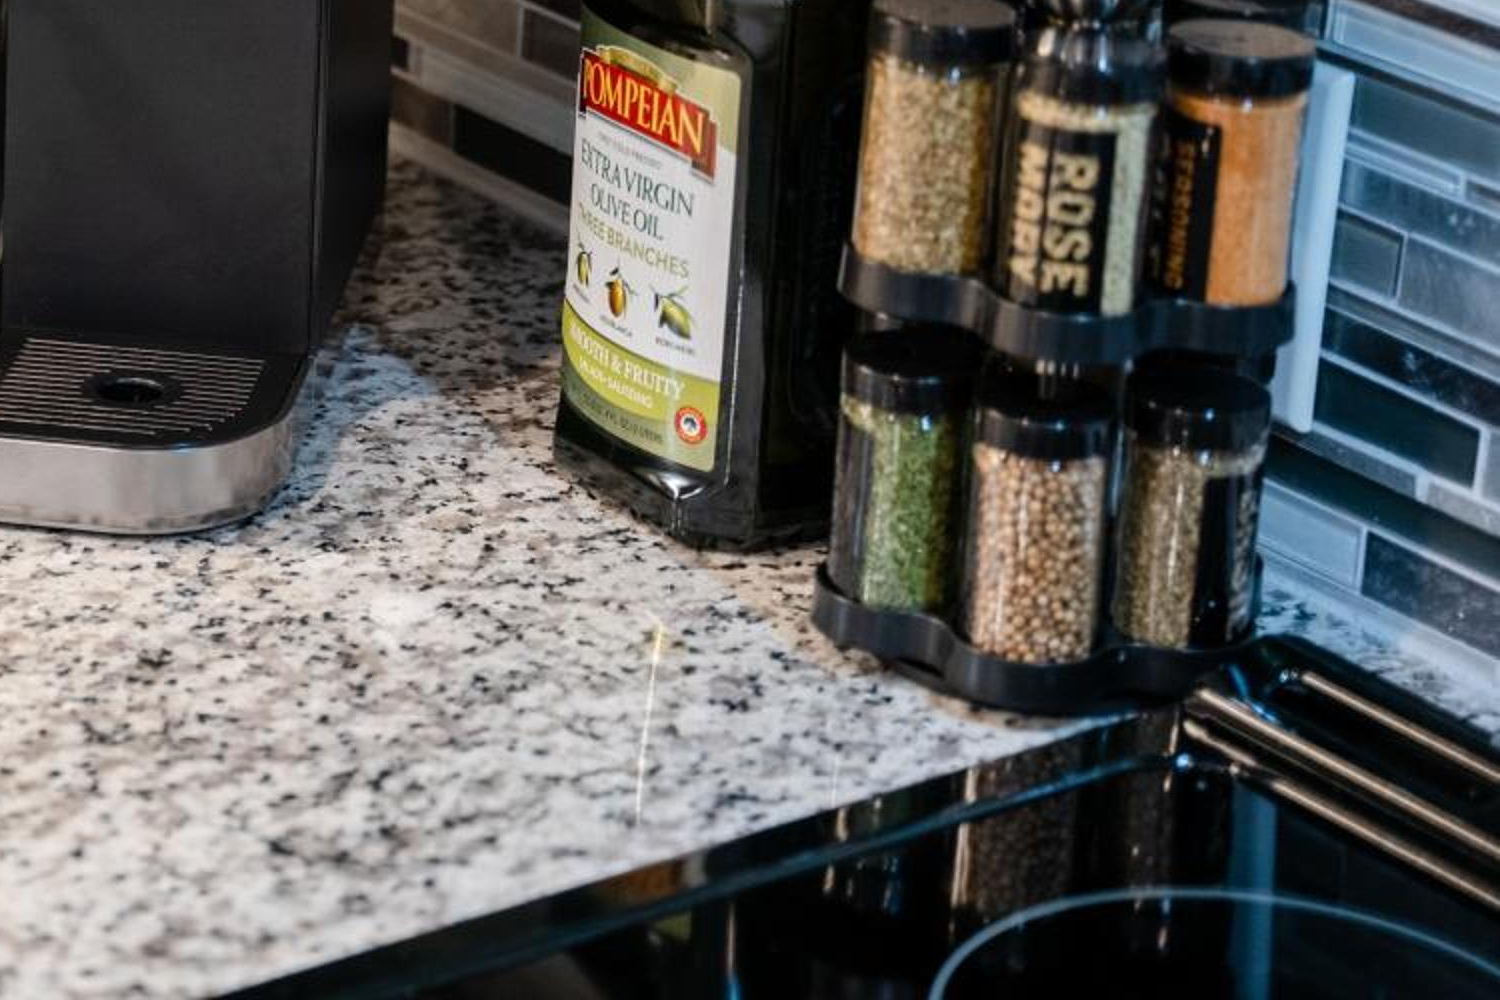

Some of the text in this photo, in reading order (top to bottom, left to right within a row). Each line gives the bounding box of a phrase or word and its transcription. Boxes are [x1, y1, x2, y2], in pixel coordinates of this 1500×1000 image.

[583, 59, 704, 154] POMPEIAN
[580, 137, 622, 188] EXTRA
[621, 164, 695, 218] VIRGIN
[590, 182, 665, 241] OLIVE OIL
[1009, 142, 1049, 288] MARY
[607, 227, 690, 279] BRANCHES
[1040, 153, 1100, 297] ROSE
[623, 361, 685, 401] FRUITY
